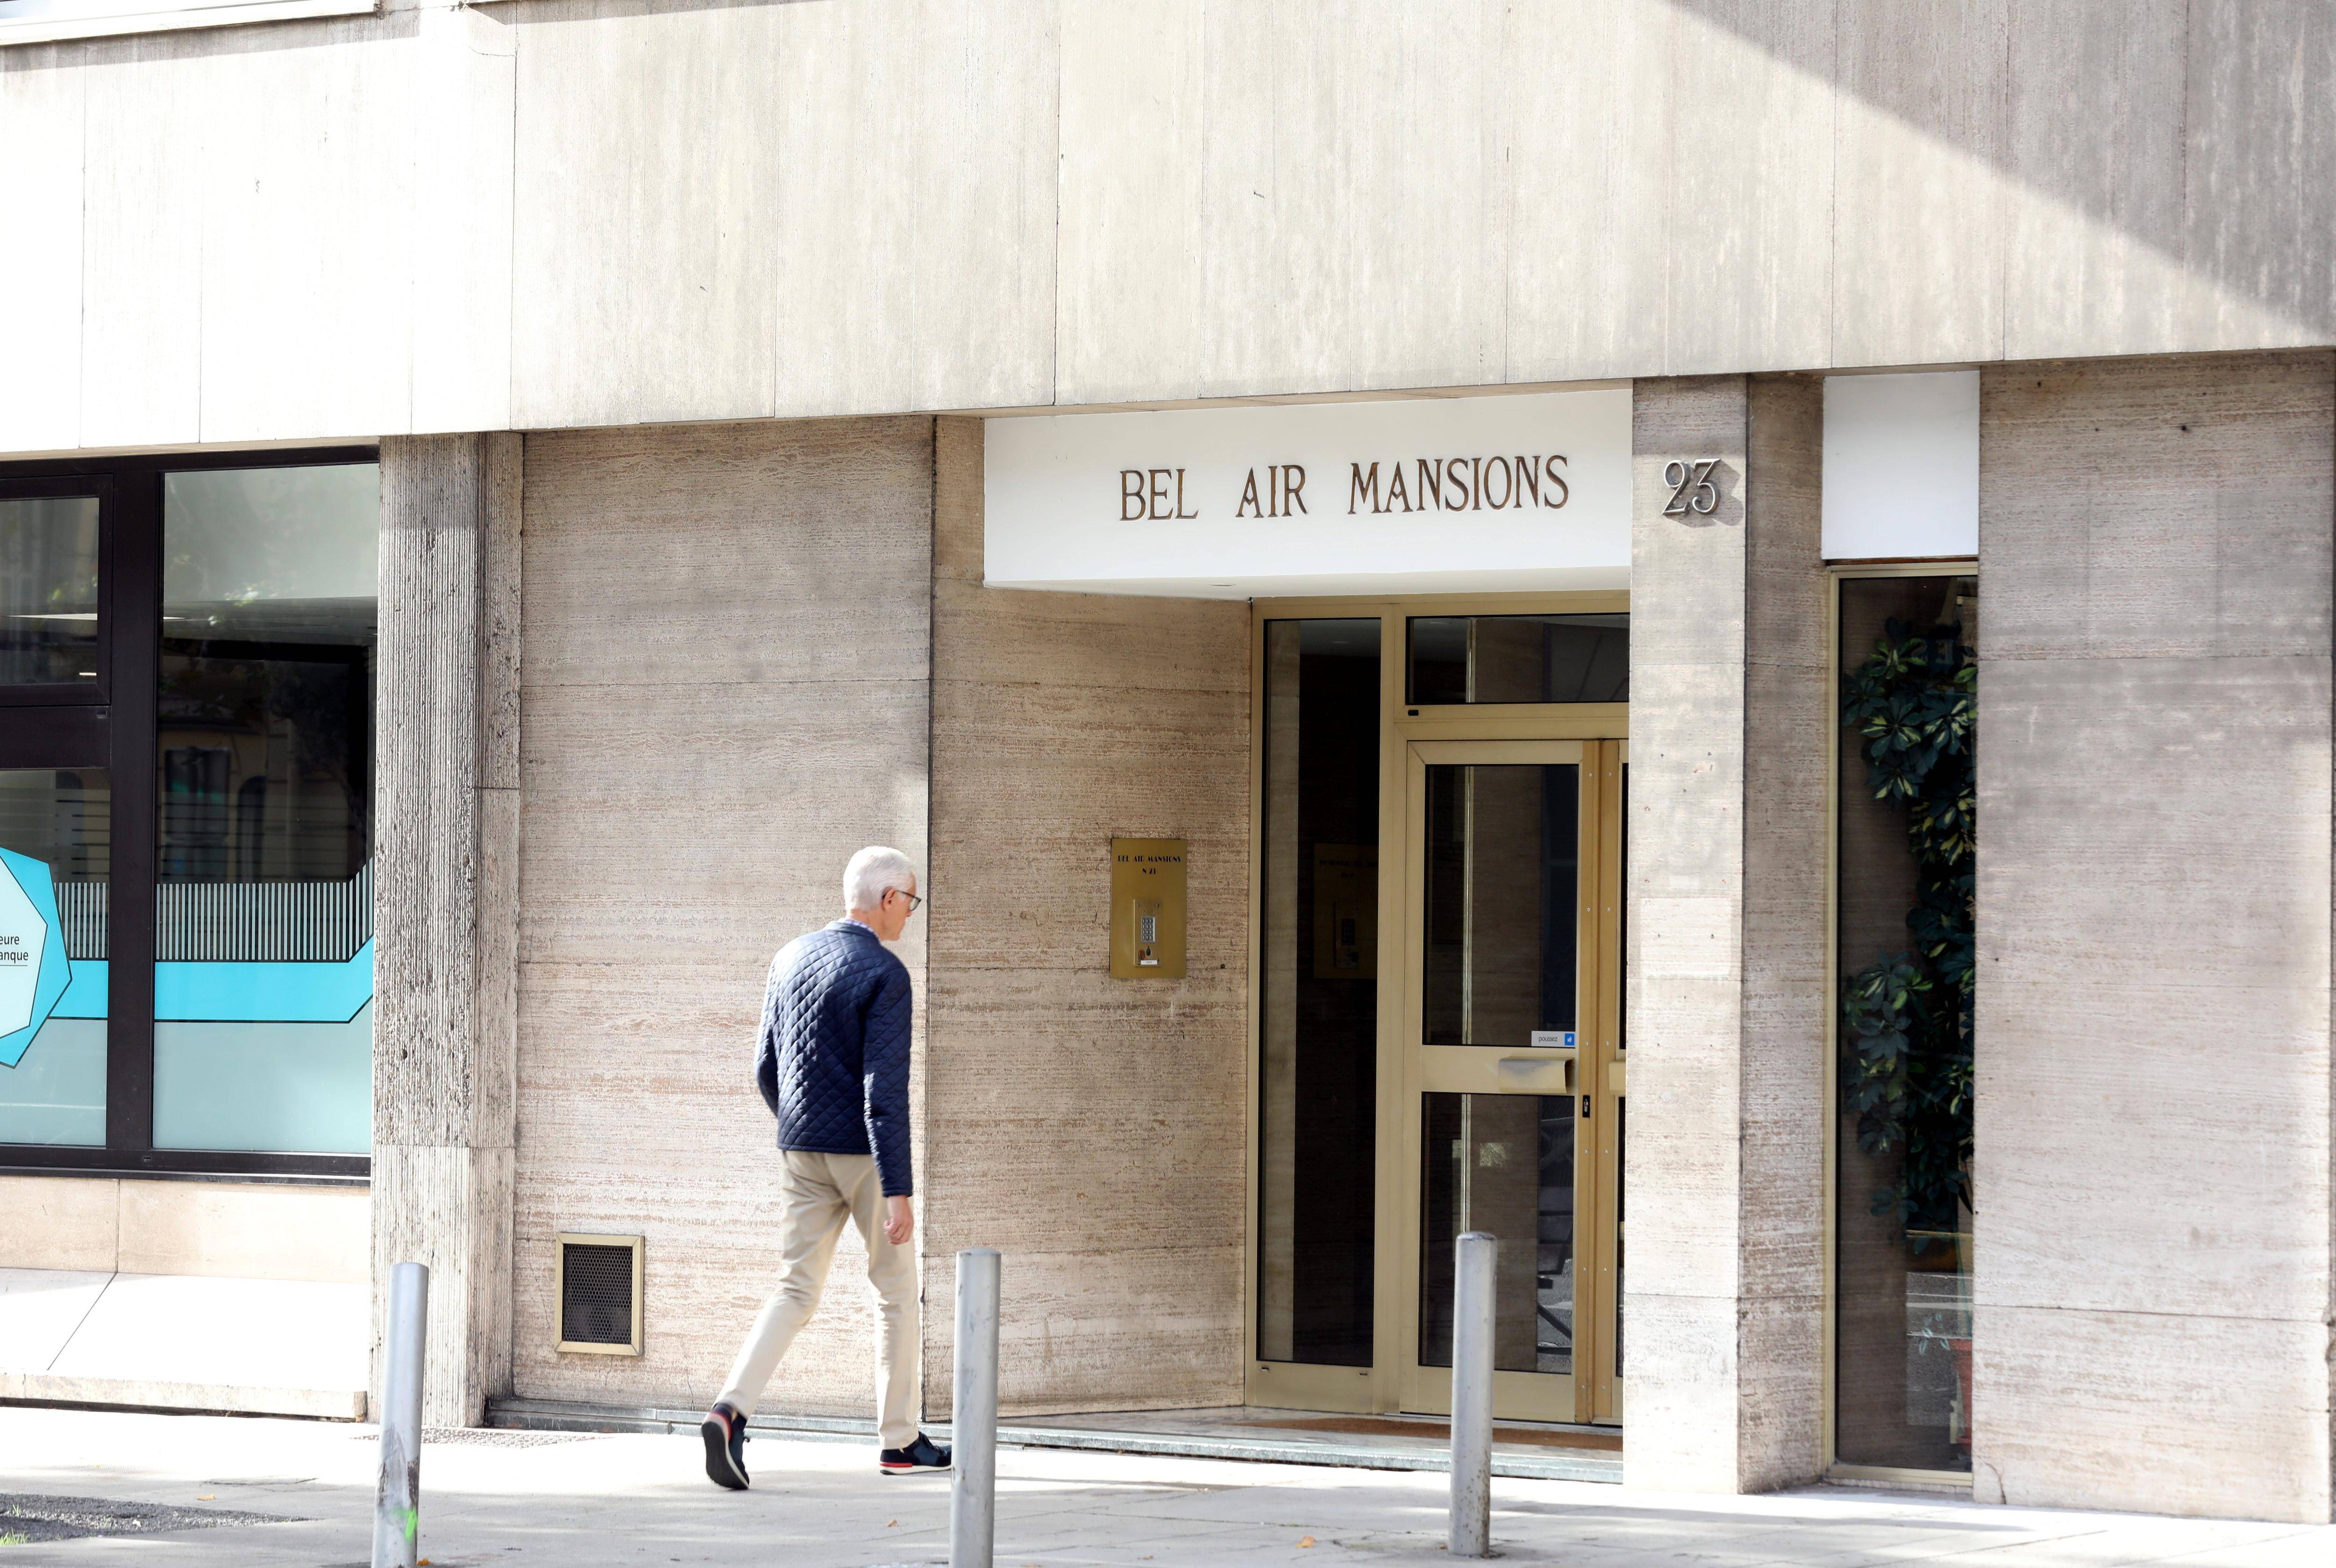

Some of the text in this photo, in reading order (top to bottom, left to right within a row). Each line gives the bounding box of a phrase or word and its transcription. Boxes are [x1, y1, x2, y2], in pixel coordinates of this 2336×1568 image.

[1119, 455, 1569, 521] BEL AIR MANSIONS
[1661, 458, 1721, 515] 23
